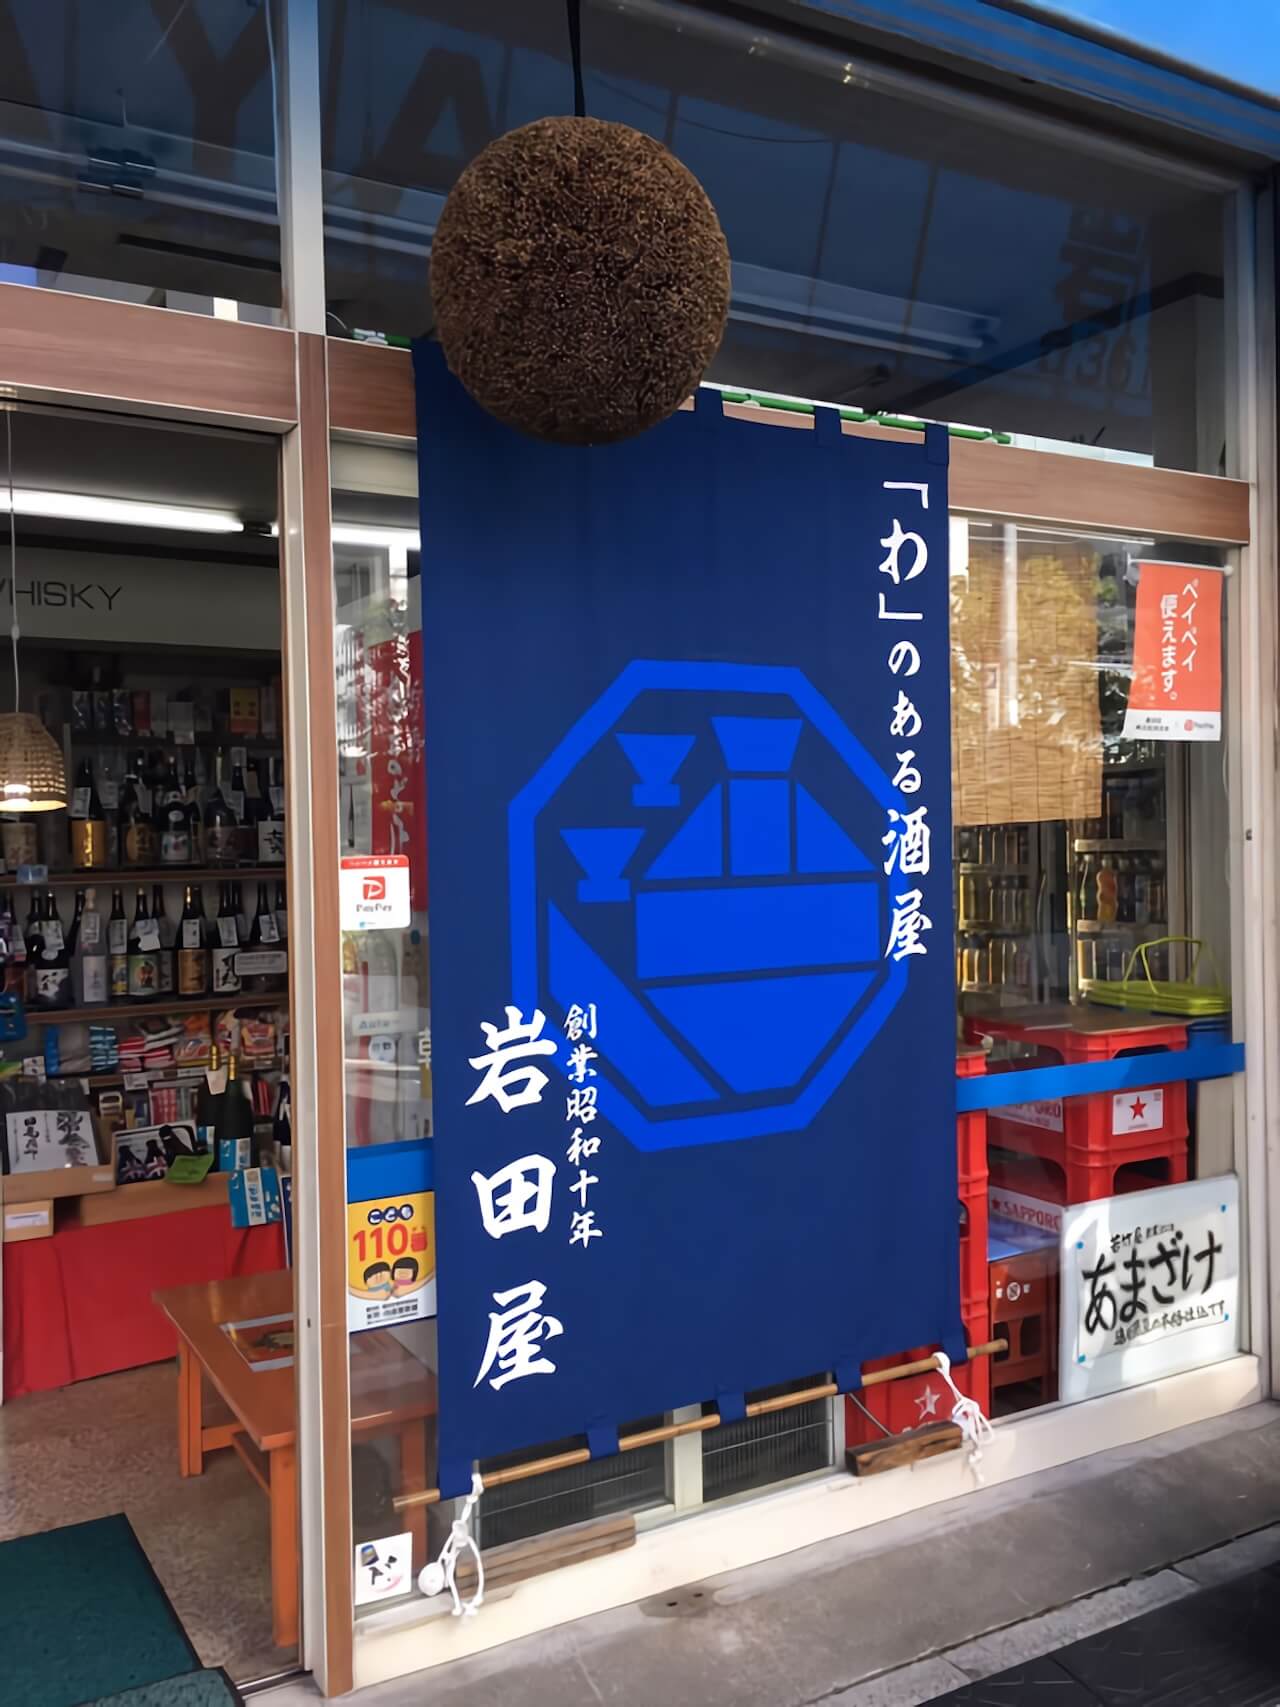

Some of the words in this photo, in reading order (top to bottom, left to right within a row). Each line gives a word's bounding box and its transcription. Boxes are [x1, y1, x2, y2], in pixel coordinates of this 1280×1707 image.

[0, 580, 122, 611] HISKY
[1160, 594, 1179, 701] 使えます。
[1180, 579, 1200, 672] ペイペイ
[878, 480, 934, 961] 「わ」のある酒屋
[564, 1003, 603, 1248] 創業昭和十年
[465, 1006, 563, 1390] 岩田屋
[1081, 1230, 1223, 1335] あまざけ
